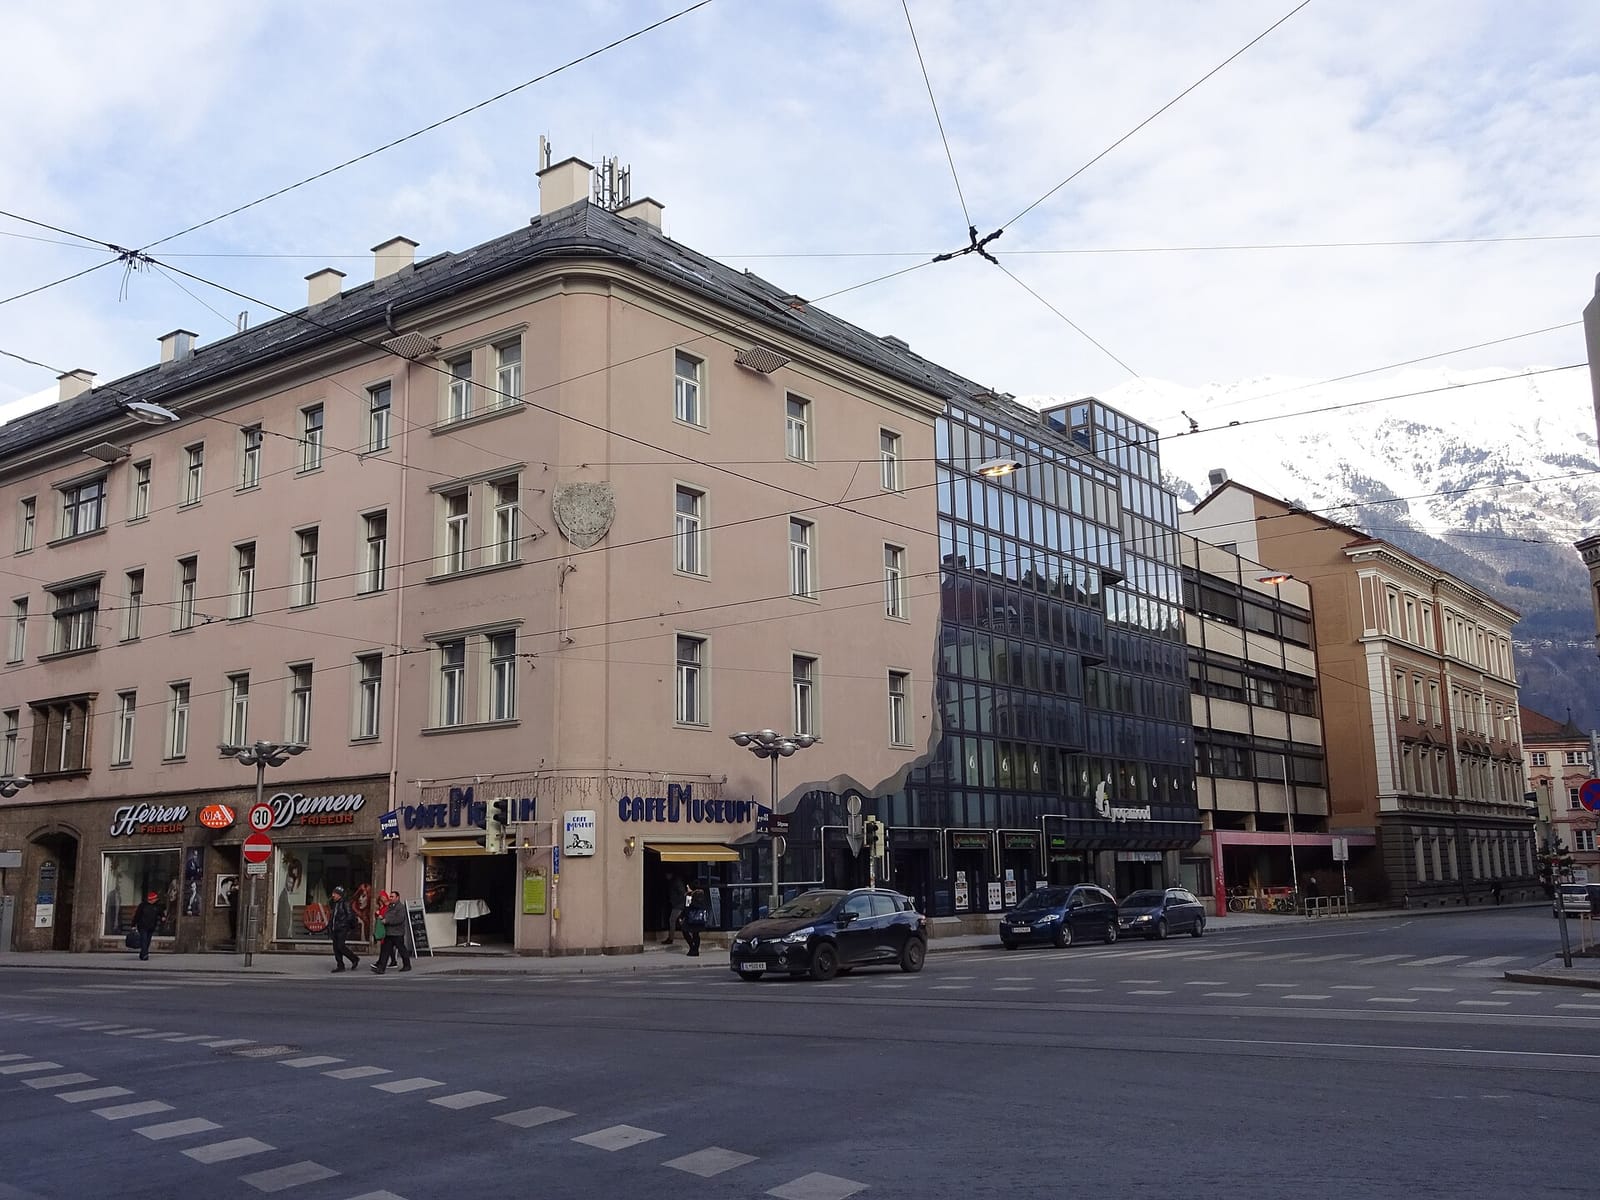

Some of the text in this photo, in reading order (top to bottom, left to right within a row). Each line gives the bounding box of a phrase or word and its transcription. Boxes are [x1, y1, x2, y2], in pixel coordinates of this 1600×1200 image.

[268, 792, 365, 827] Damen
[404, 803, 447, 829] CAFE
[619, 784, 750, 823] CAFE MUSEUM
[110, 802, 188, 836] Herren
[140, 824, 184, 834] FRISEUR
[254, 810, 268, 825] 30
[301, 814, 353, 825] FRISEUR
